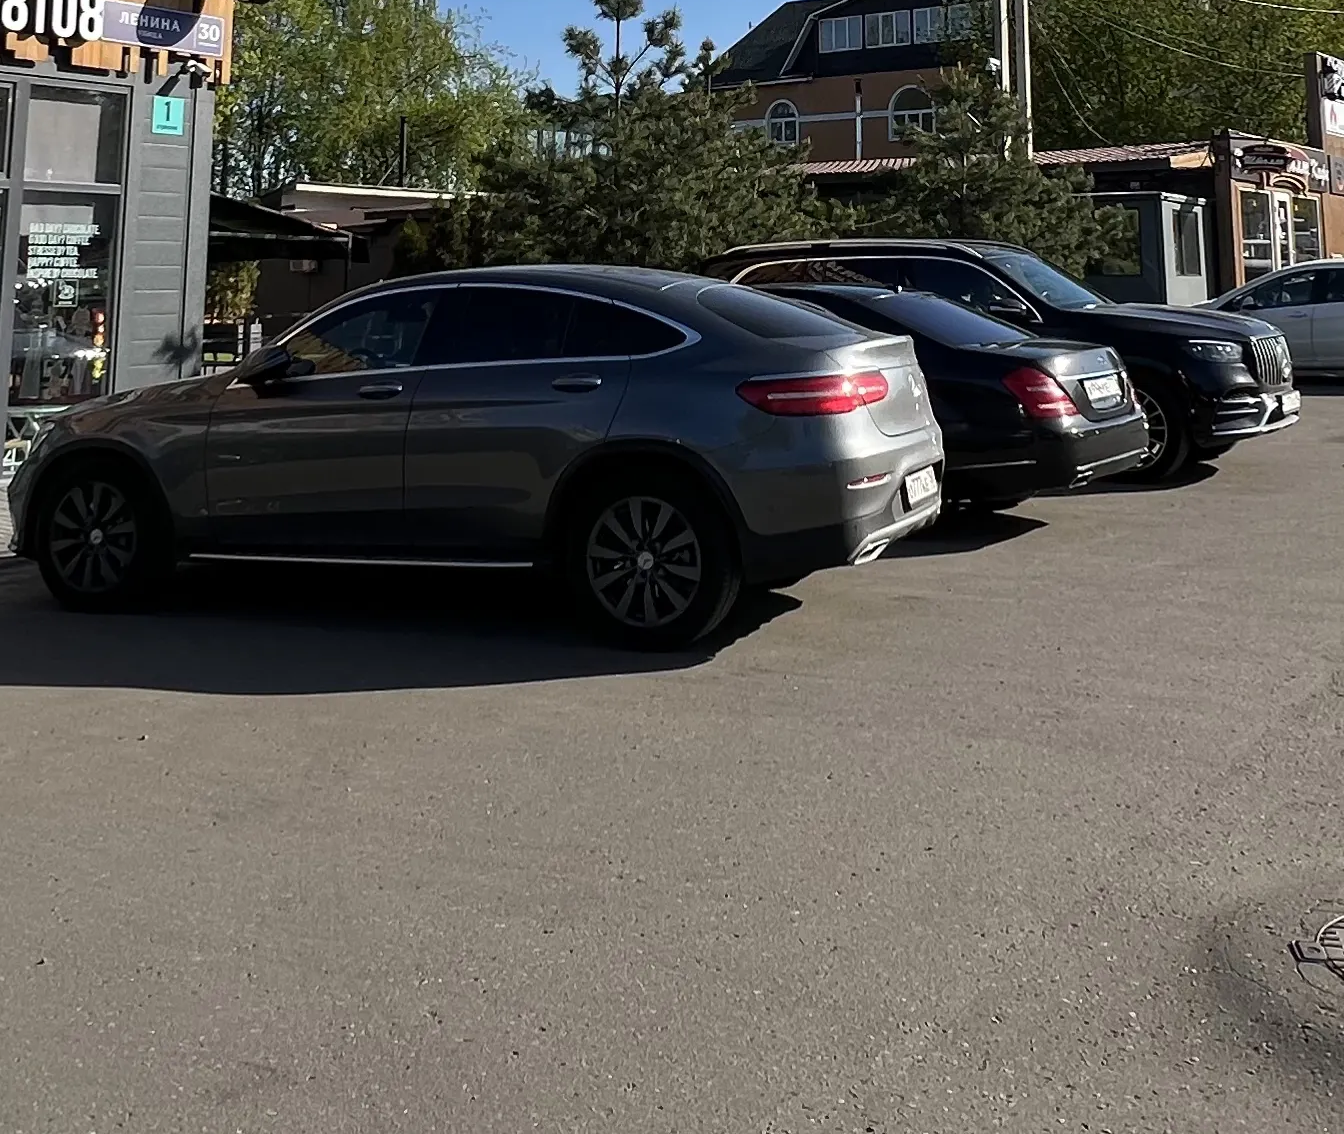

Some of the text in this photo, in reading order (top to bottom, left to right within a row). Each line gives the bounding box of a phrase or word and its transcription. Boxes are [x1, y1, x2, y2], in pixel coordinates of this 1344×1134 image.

[118, 11, 221, 42] ЛЕНИНА 30
[164, 100, 172, 122] 1
